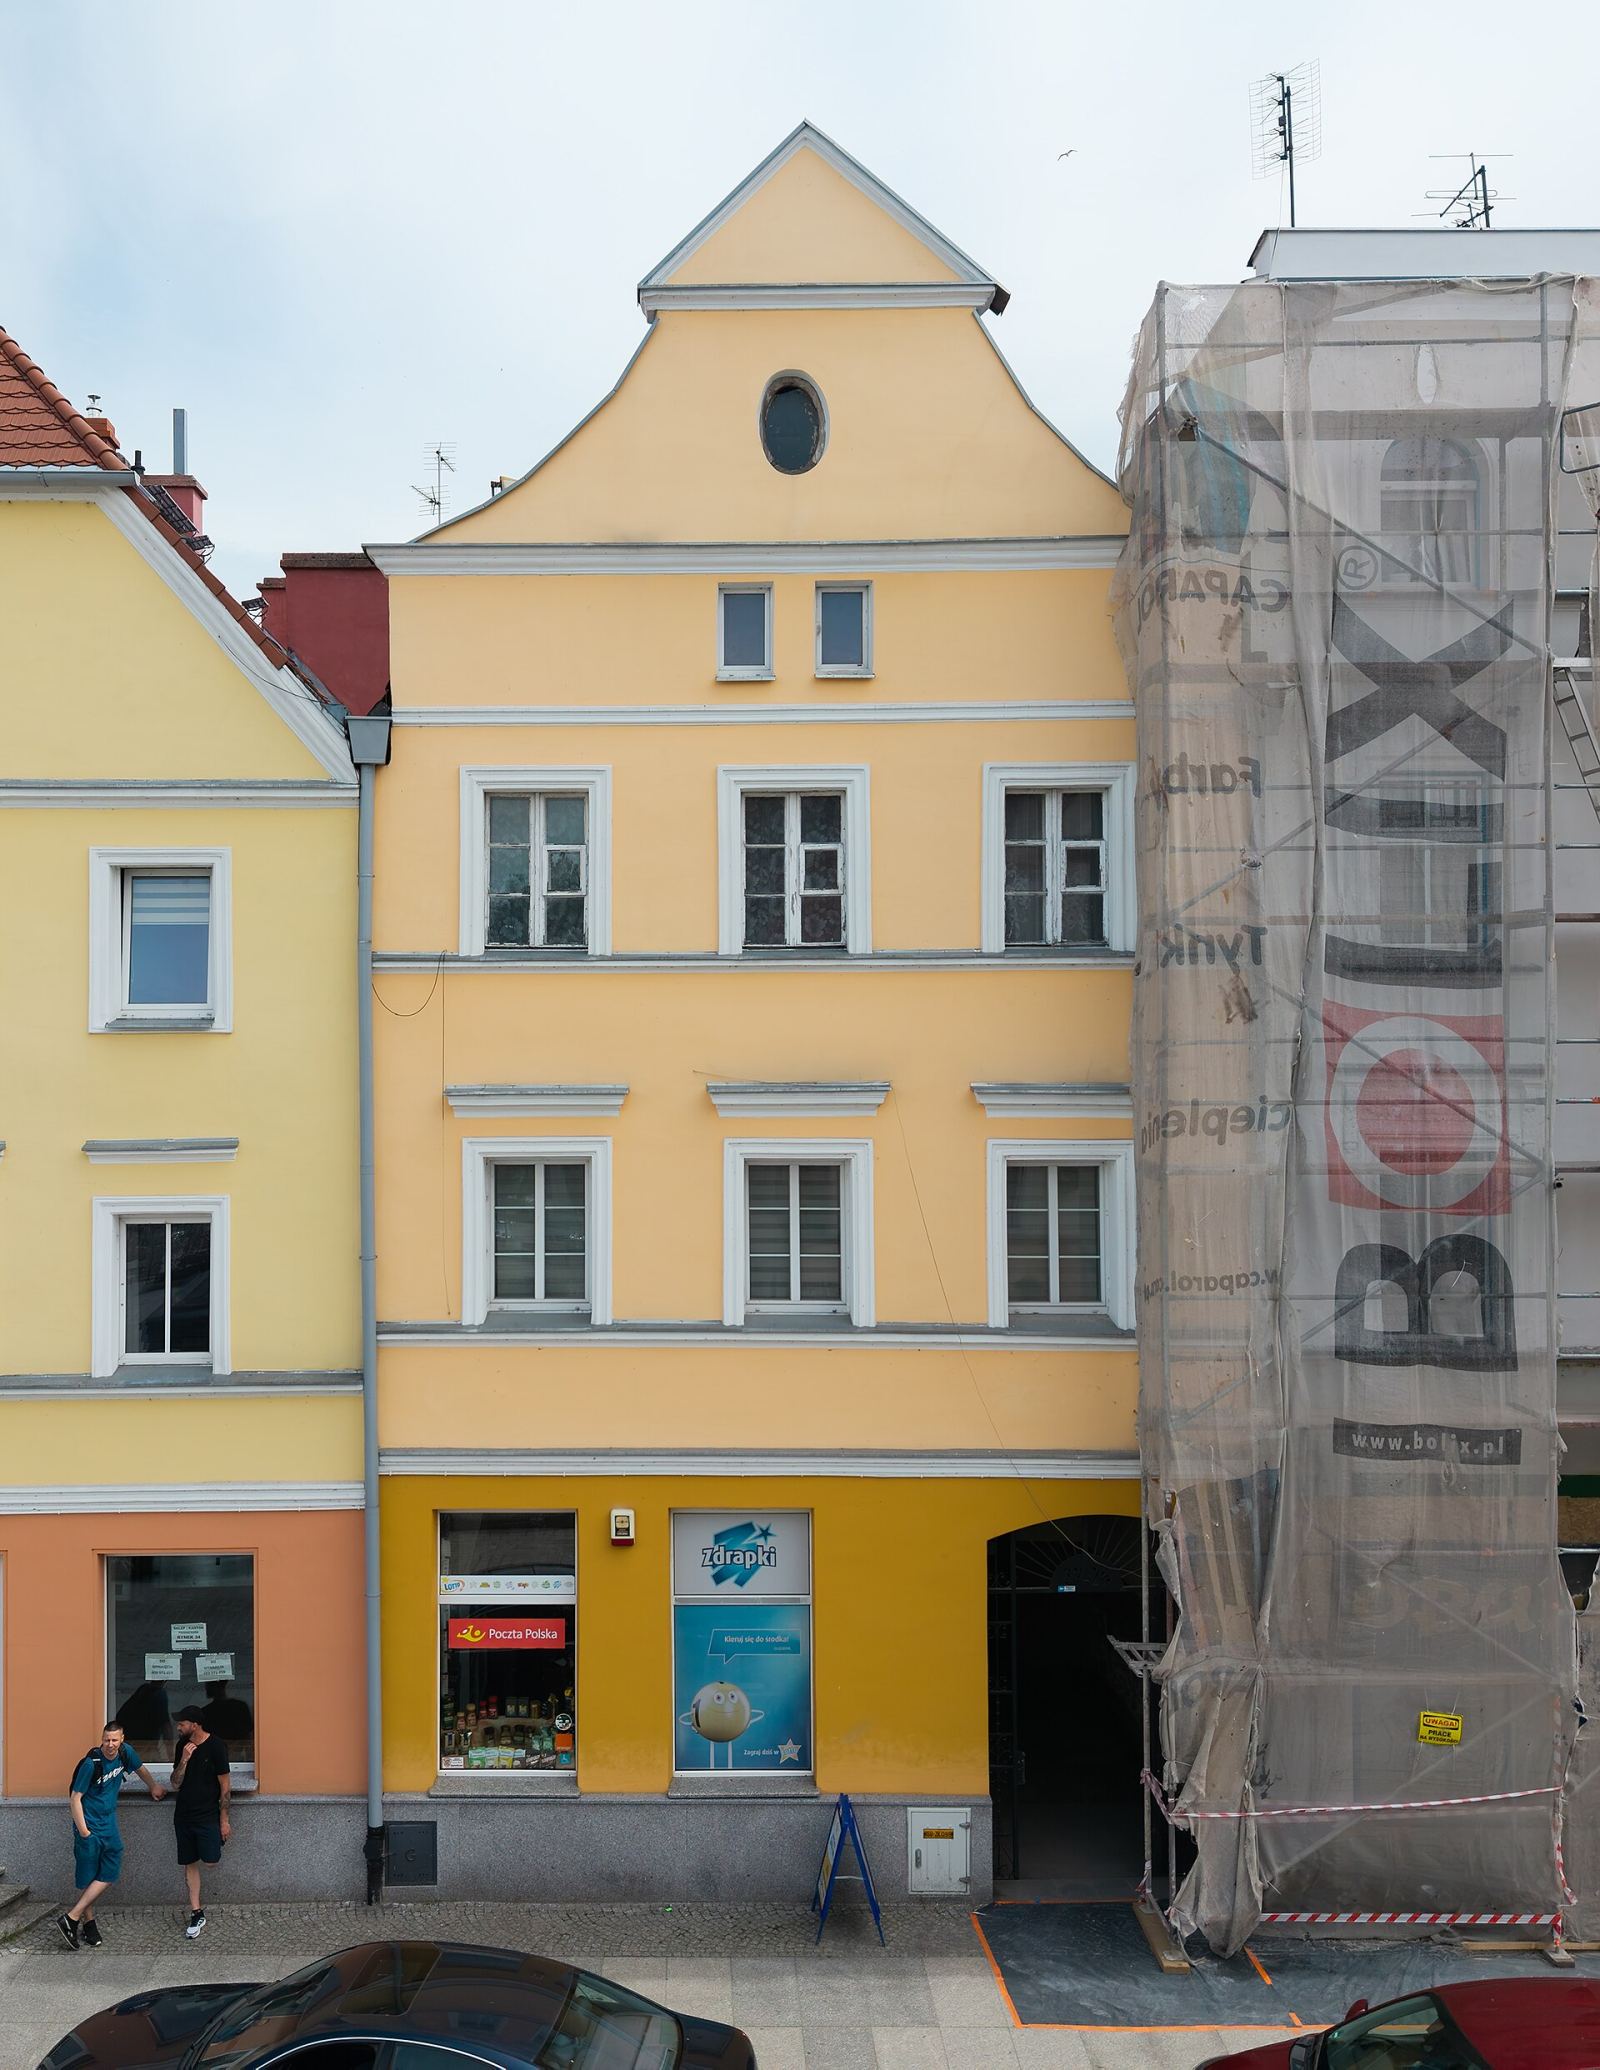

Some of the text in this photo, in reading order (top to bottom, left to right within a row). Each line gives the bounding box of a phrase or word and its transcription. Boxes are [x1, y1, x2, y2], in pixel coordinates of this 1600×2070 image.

[1351, 1430, 1504, 1458] www.bolix.pl
[701, 1545, 777, 1570] Zdrapki
[489, 1628, 558, 1639] Poczta Polska
[1425, 1718, 1457, 1727] UWAGA!
